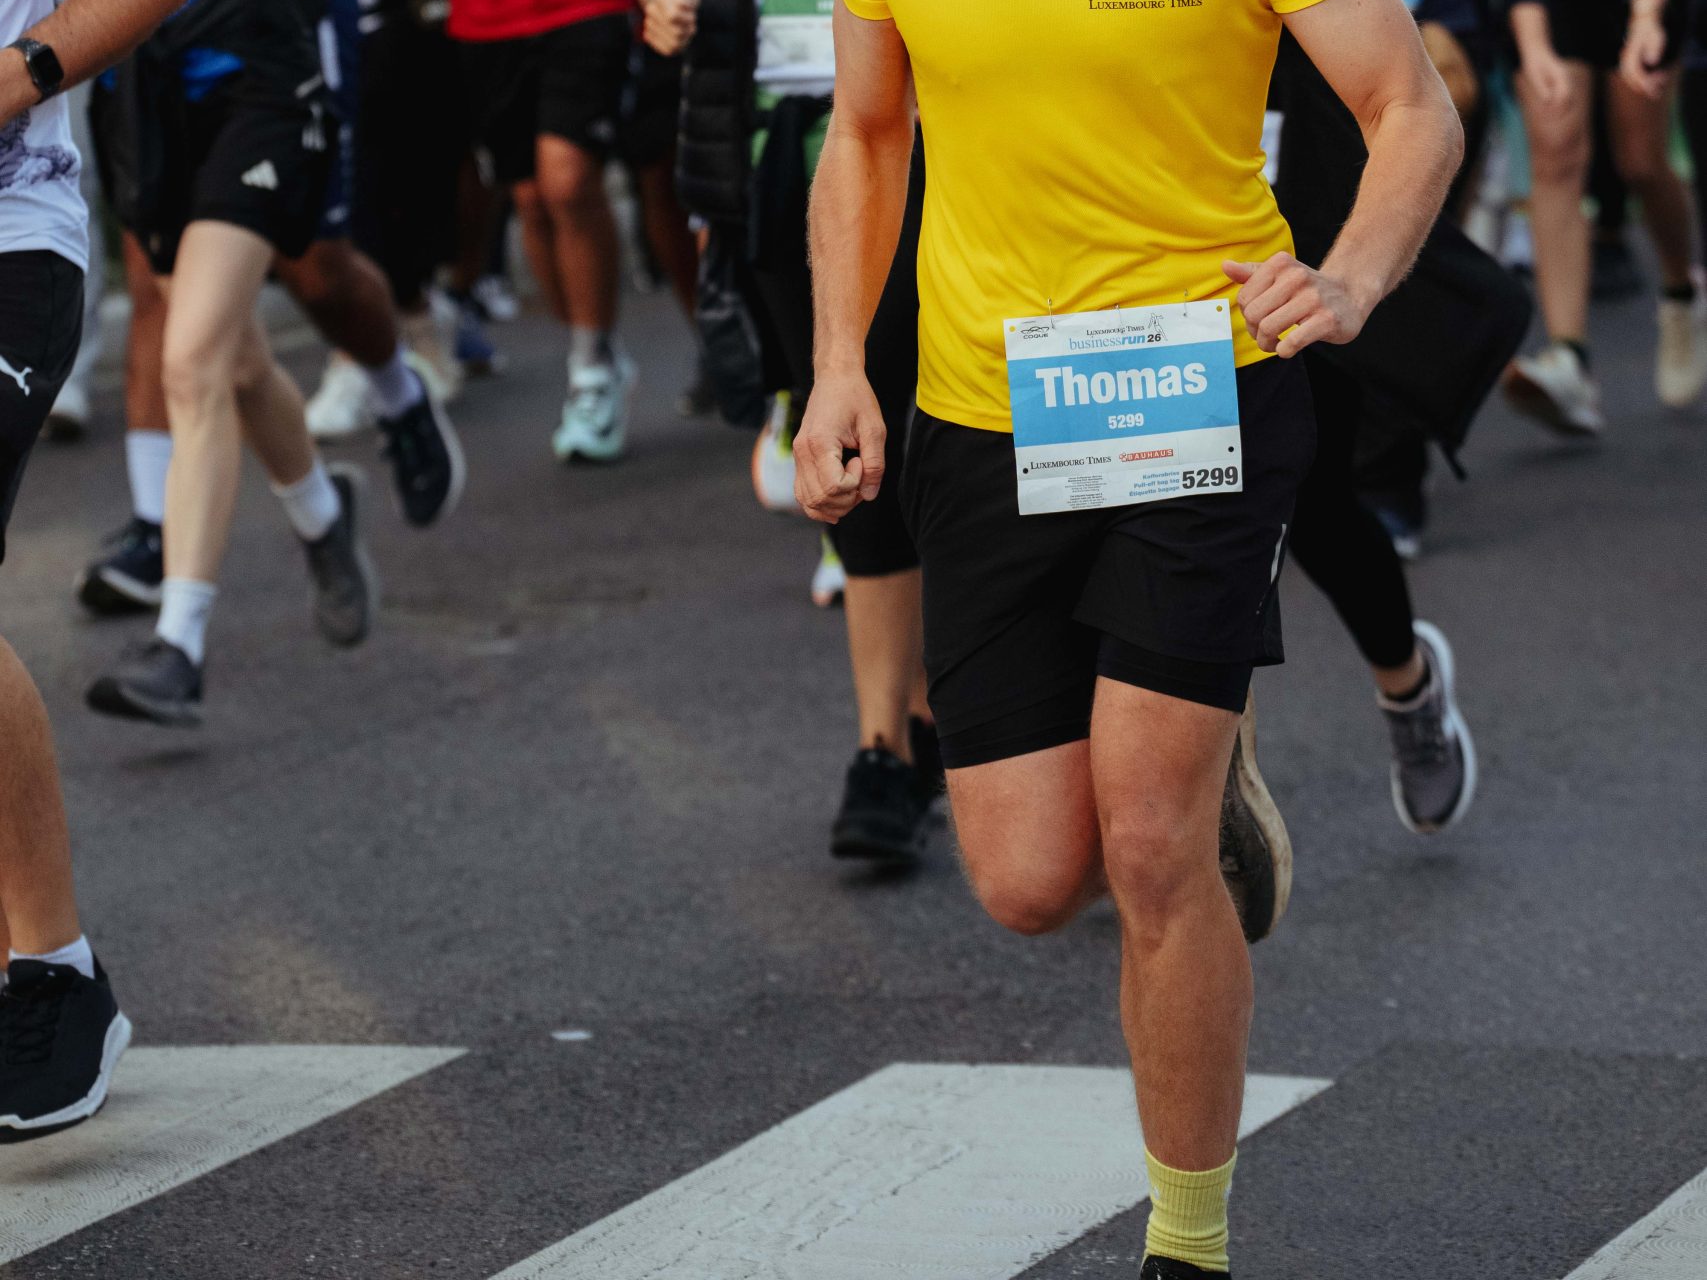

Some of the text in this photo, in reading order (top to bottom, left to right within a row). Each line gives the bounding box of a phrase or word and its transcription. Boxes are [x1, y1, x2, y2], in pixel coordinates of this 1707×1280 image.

[1146, 333, 1162, 343] 26
[1035, 362, 1208, 408] Thomas
[1107, 412, 1144, 430] 5299
[1128, 449, 1174, 461] BAUHAUS
[1182, 466, 1239, 490] 5299
